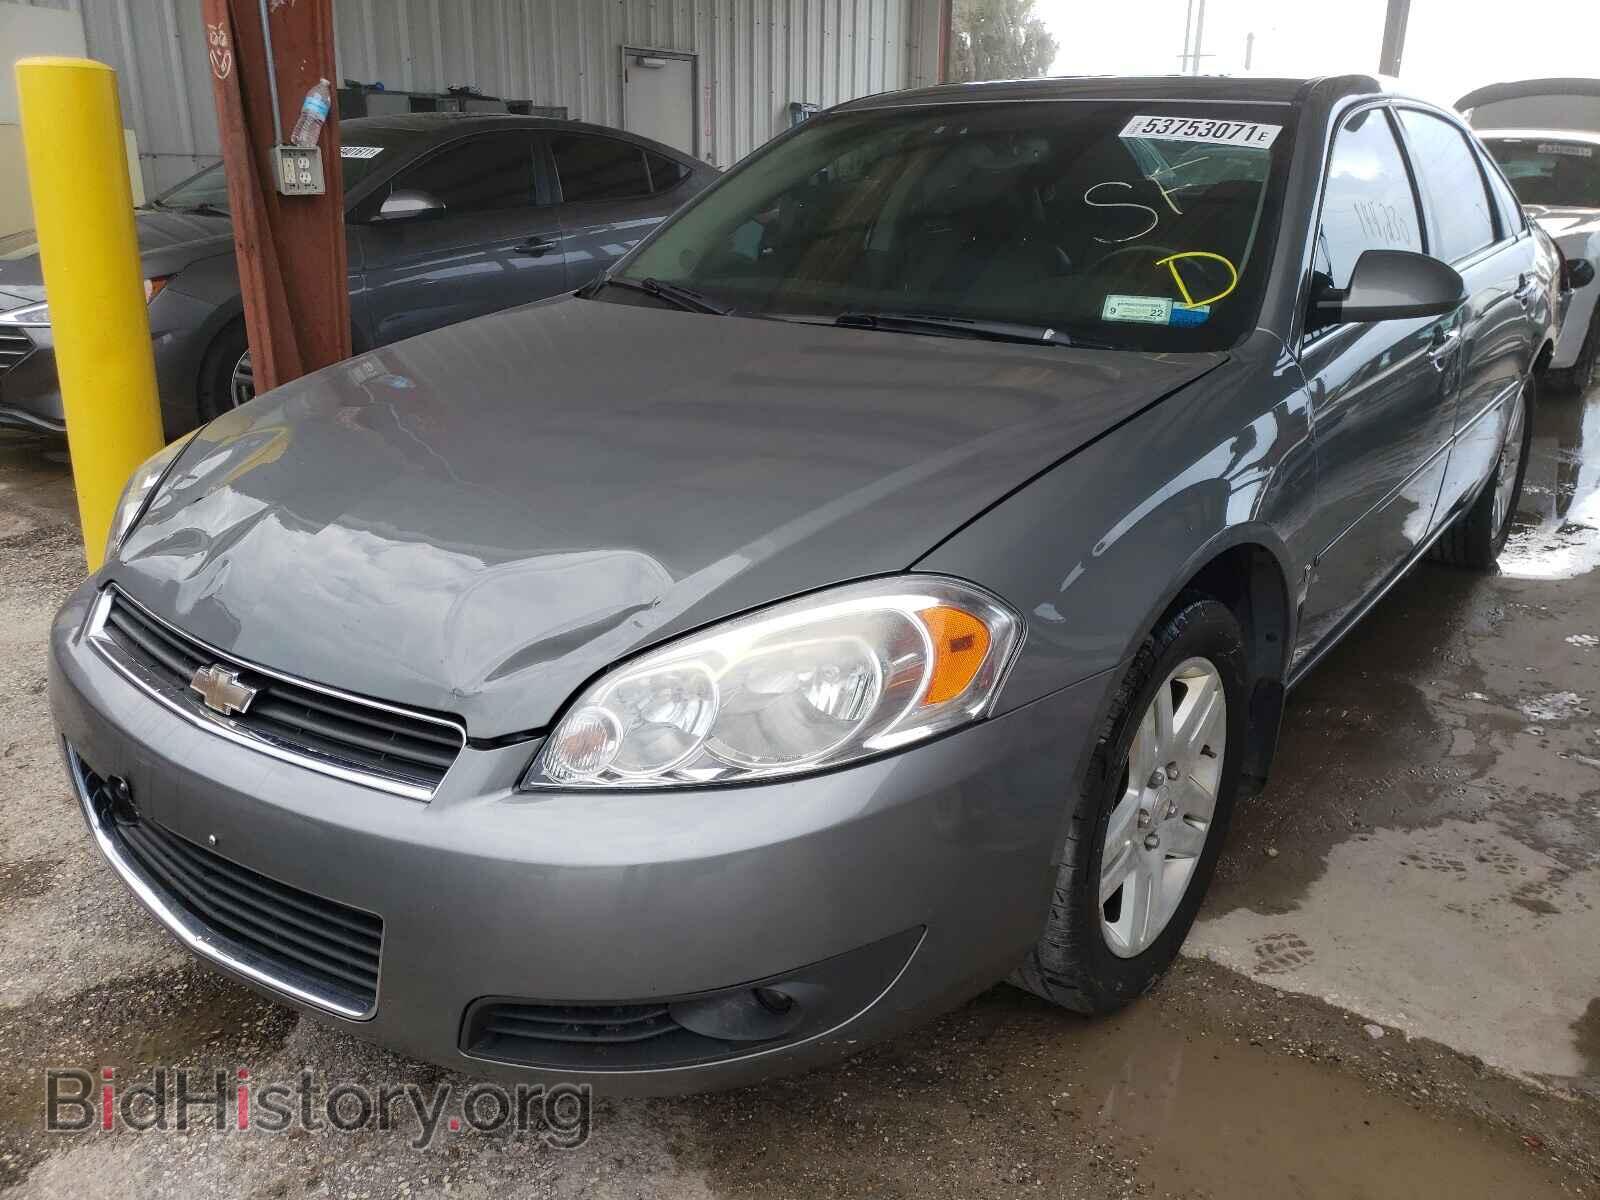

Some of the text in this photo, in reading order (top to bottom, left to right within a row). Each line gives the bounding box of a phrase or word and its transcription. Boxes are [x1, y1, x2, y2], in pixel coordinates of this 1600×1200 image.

[1141, 118, 1259, 142] 53753071
[1257, 131, 1270, 143] E
[1155, 251, 1238, 309] D
[1109, 307, 1164, 317] 9 22
